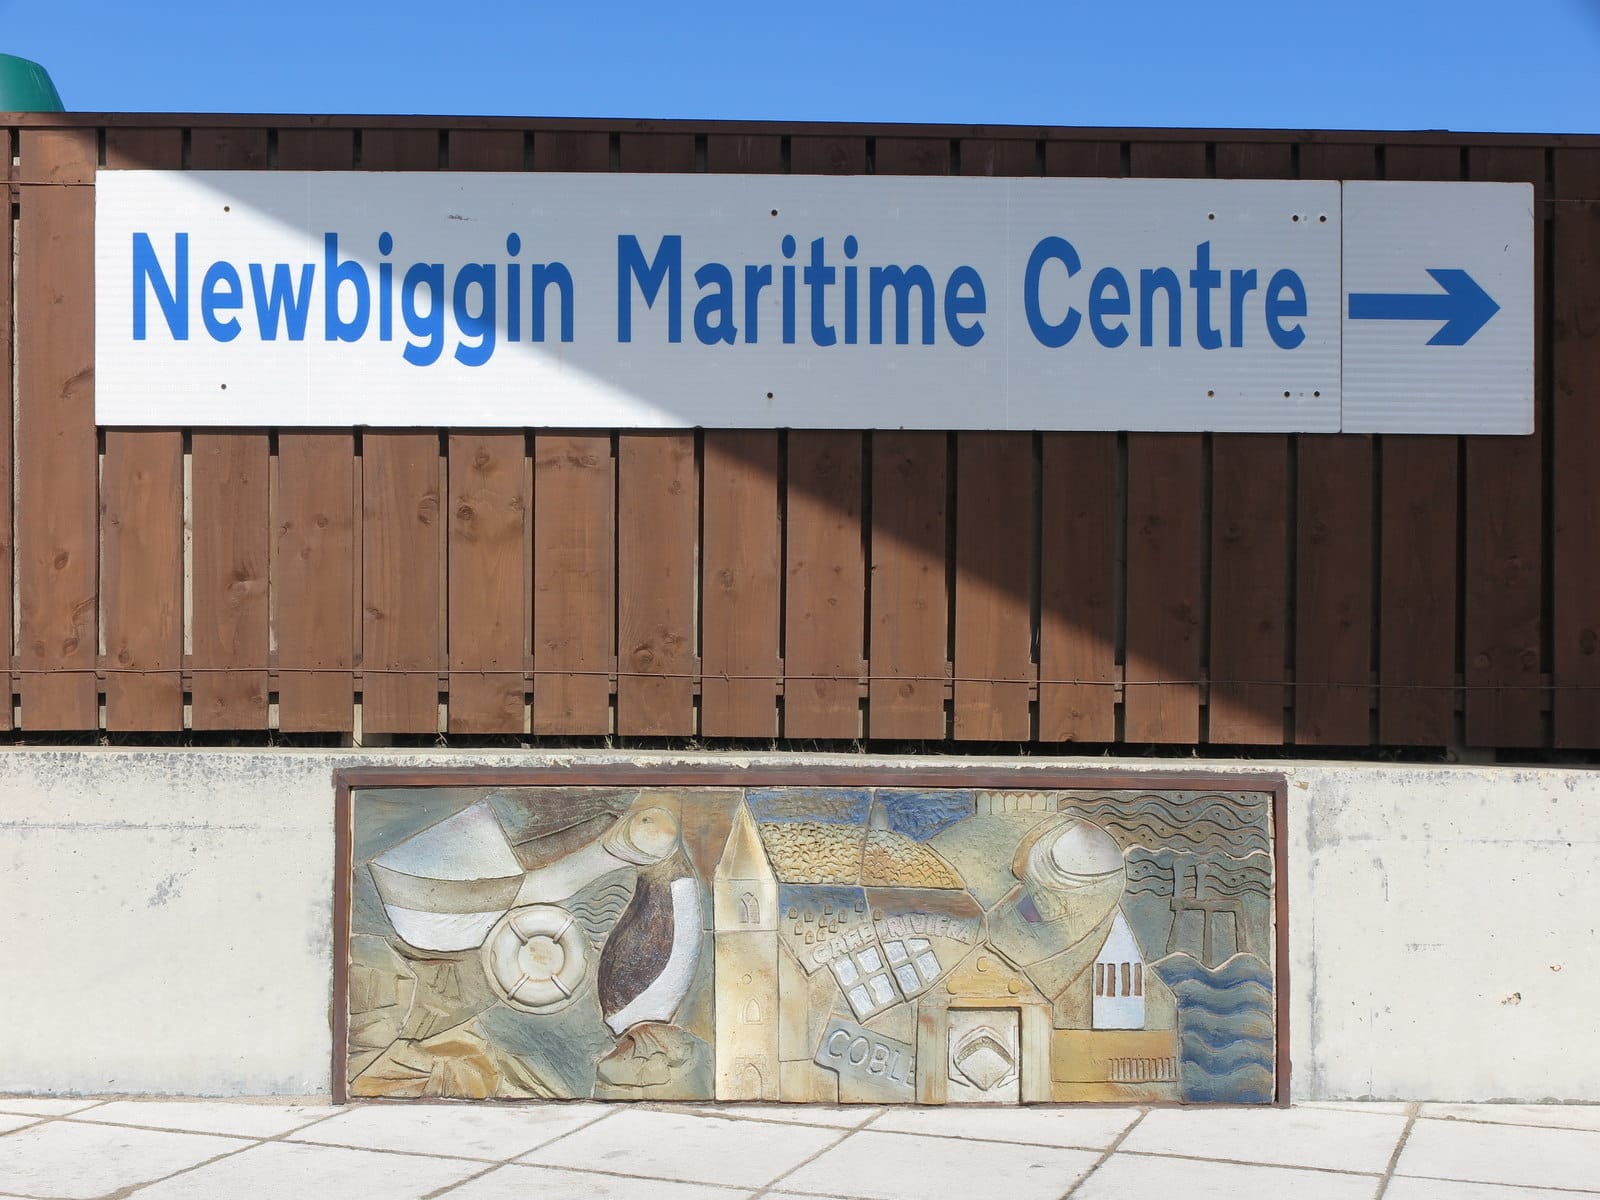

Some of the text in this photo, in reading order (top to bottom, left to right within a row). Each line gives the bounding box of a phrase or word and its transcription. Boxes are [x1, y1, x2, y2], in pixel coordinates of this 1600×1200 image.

[133, 231, 1308, 367] Newbiggin Maritime Centre
